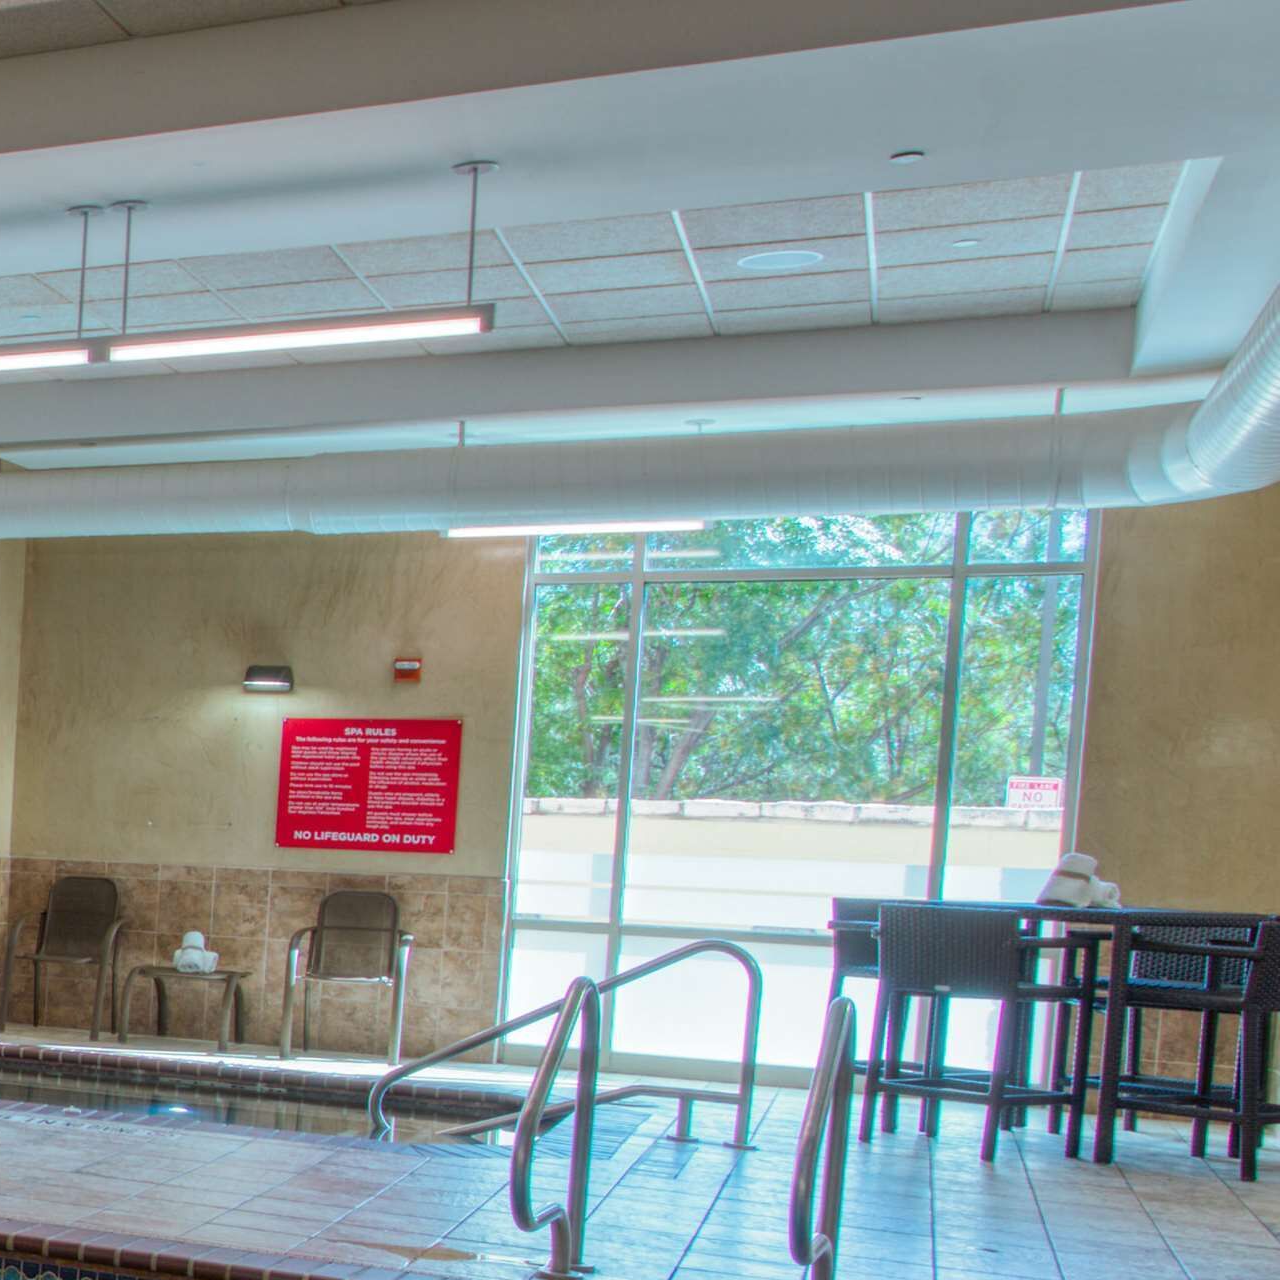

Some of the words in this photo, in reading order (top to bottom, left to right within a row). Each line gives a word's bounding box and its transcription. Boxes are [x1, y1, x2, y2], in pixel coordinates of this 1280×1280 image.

[344, 727, 363, 736] SPA
[365, 728, 397, 737] RULES
[1022, 791, 1042, 802] NO
[293, 830, 312, 840] NO
[314, 831, 380, 842] LIFEGUARD
[382, 833, 400, 843] ON
[403, 834, 436, 845] DUTY
